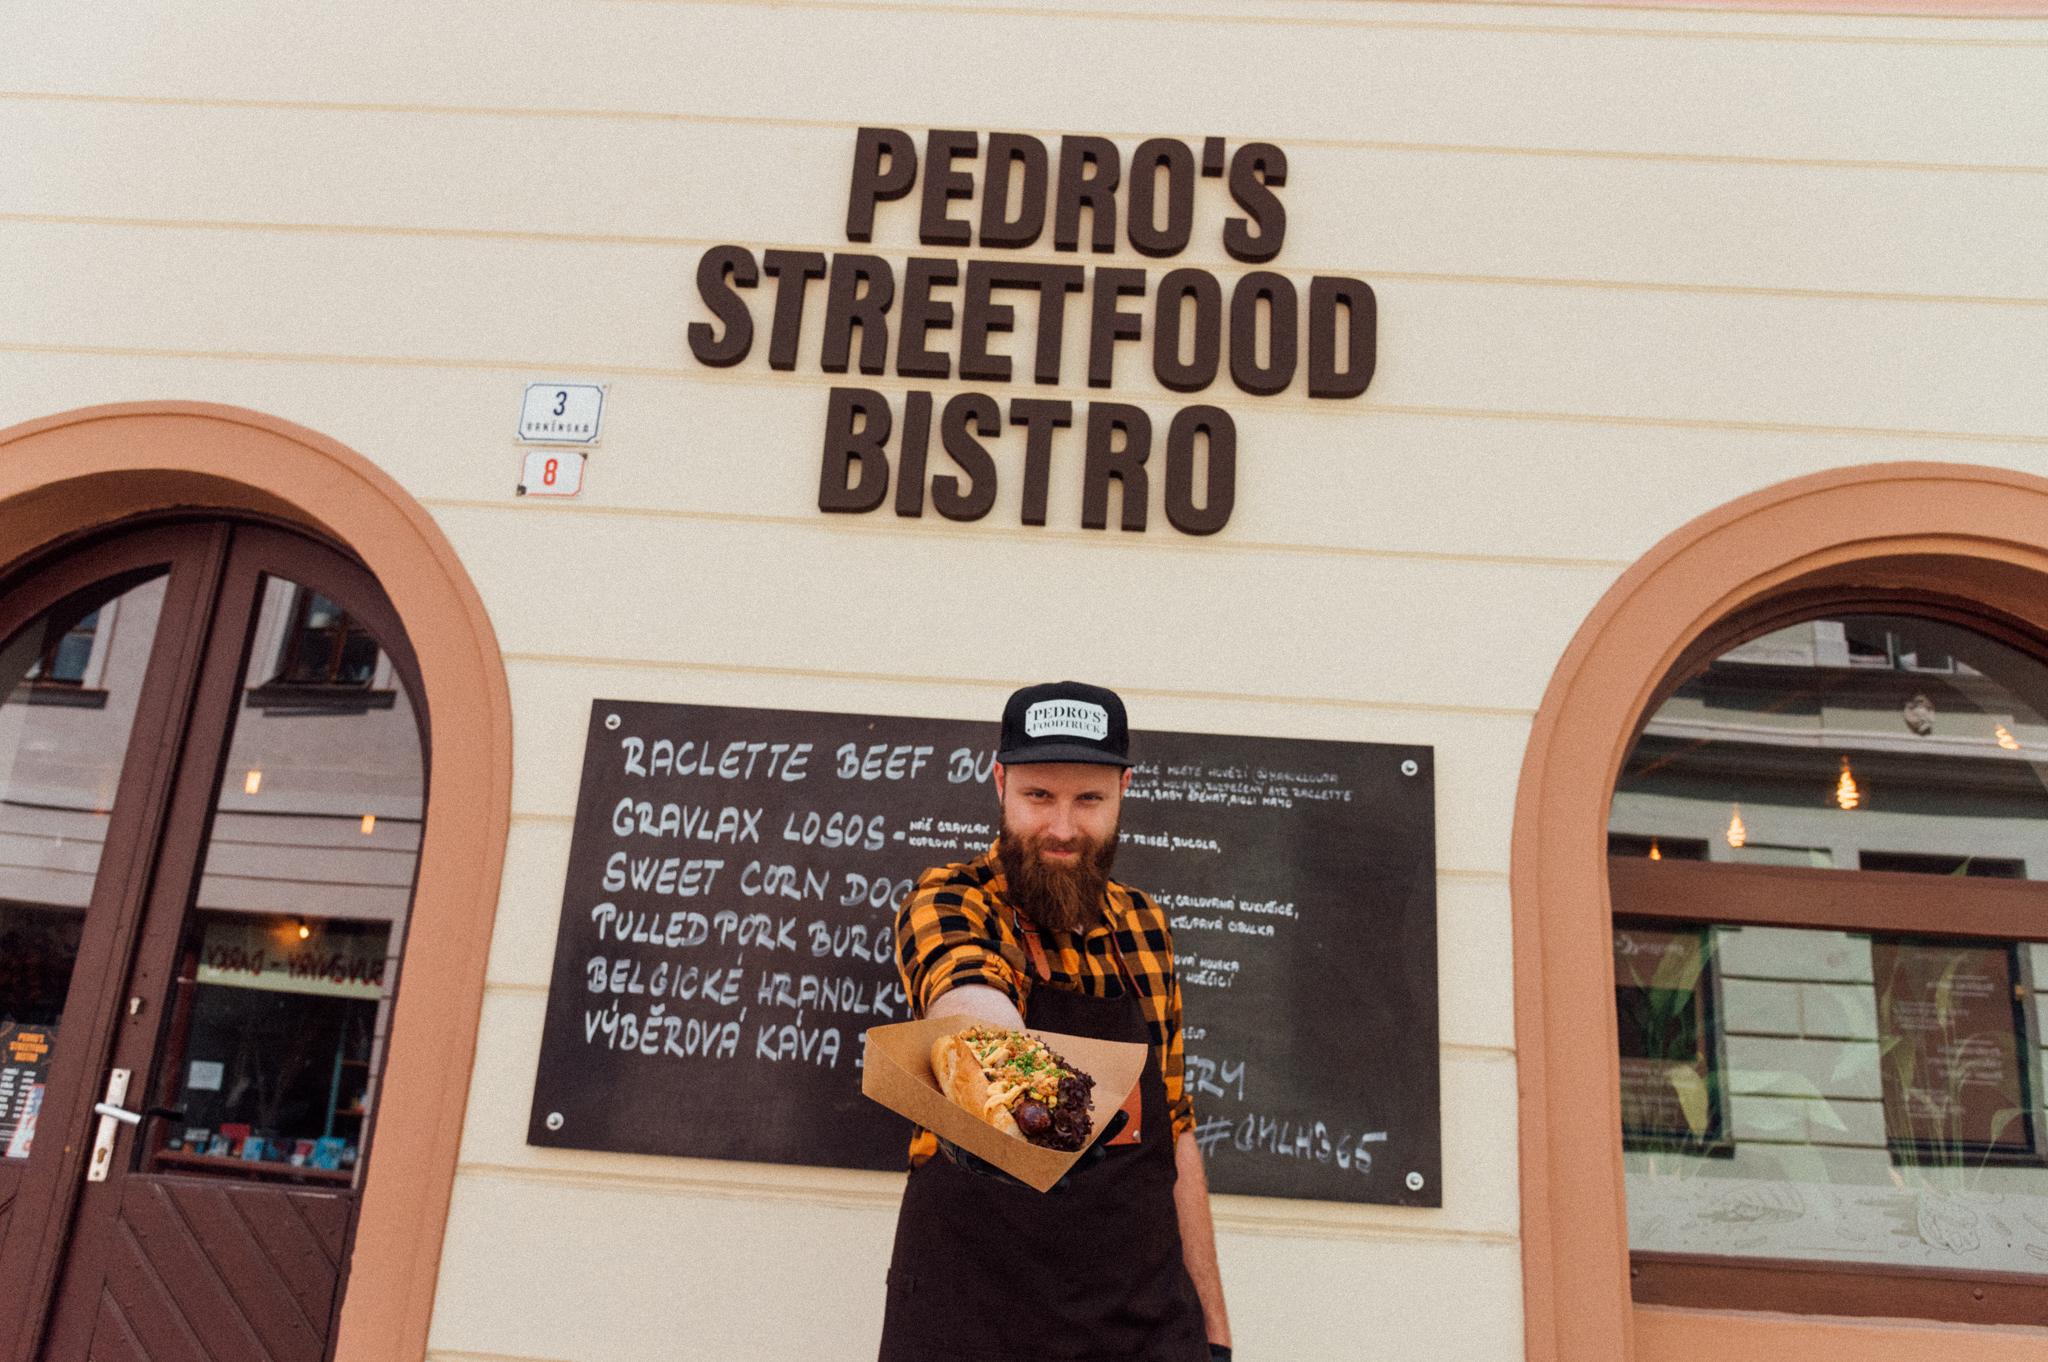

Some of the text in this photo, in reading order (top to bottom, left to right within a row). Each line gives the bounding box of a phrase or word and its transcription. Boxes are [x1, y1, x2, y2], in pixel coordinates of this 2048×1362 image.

[846, 127, 1288, 264] PEDRO'S
[688, 244, 1378, 400] STREETFOOD
[553, 391, 567, 416] 3
[543, 458, 559, 486] 8
[818, 386, 1238, 537] BISTRO
[1032, 718, 1102, 735] FOODTRUCK
[1034, 706, 1102, 724] PEDRO'S
[622, 736, 998, 784] RACLETTE BEEF BU
[612, 797, 765, 845] GRAVLAX
[784, 811, 886, 851] LOSOS
[909, 816, 990, 834] NÁŠ GRAVLAX
[1262, 796, 1293, 809] MAYO
[603, 851, 724, 897] SWEET
[740, 860, 831, 902] CORN
[592, 902, 899, 965] PULLED PORK BURG
[587, 952, 745, 1006] BELGICKÉ
[1174, 951, 1198, 967] OVÁ
[585, 999, 747, 1059] VÝBĚROVÁ
[756, 1009, 842, 1070] KÁVA
